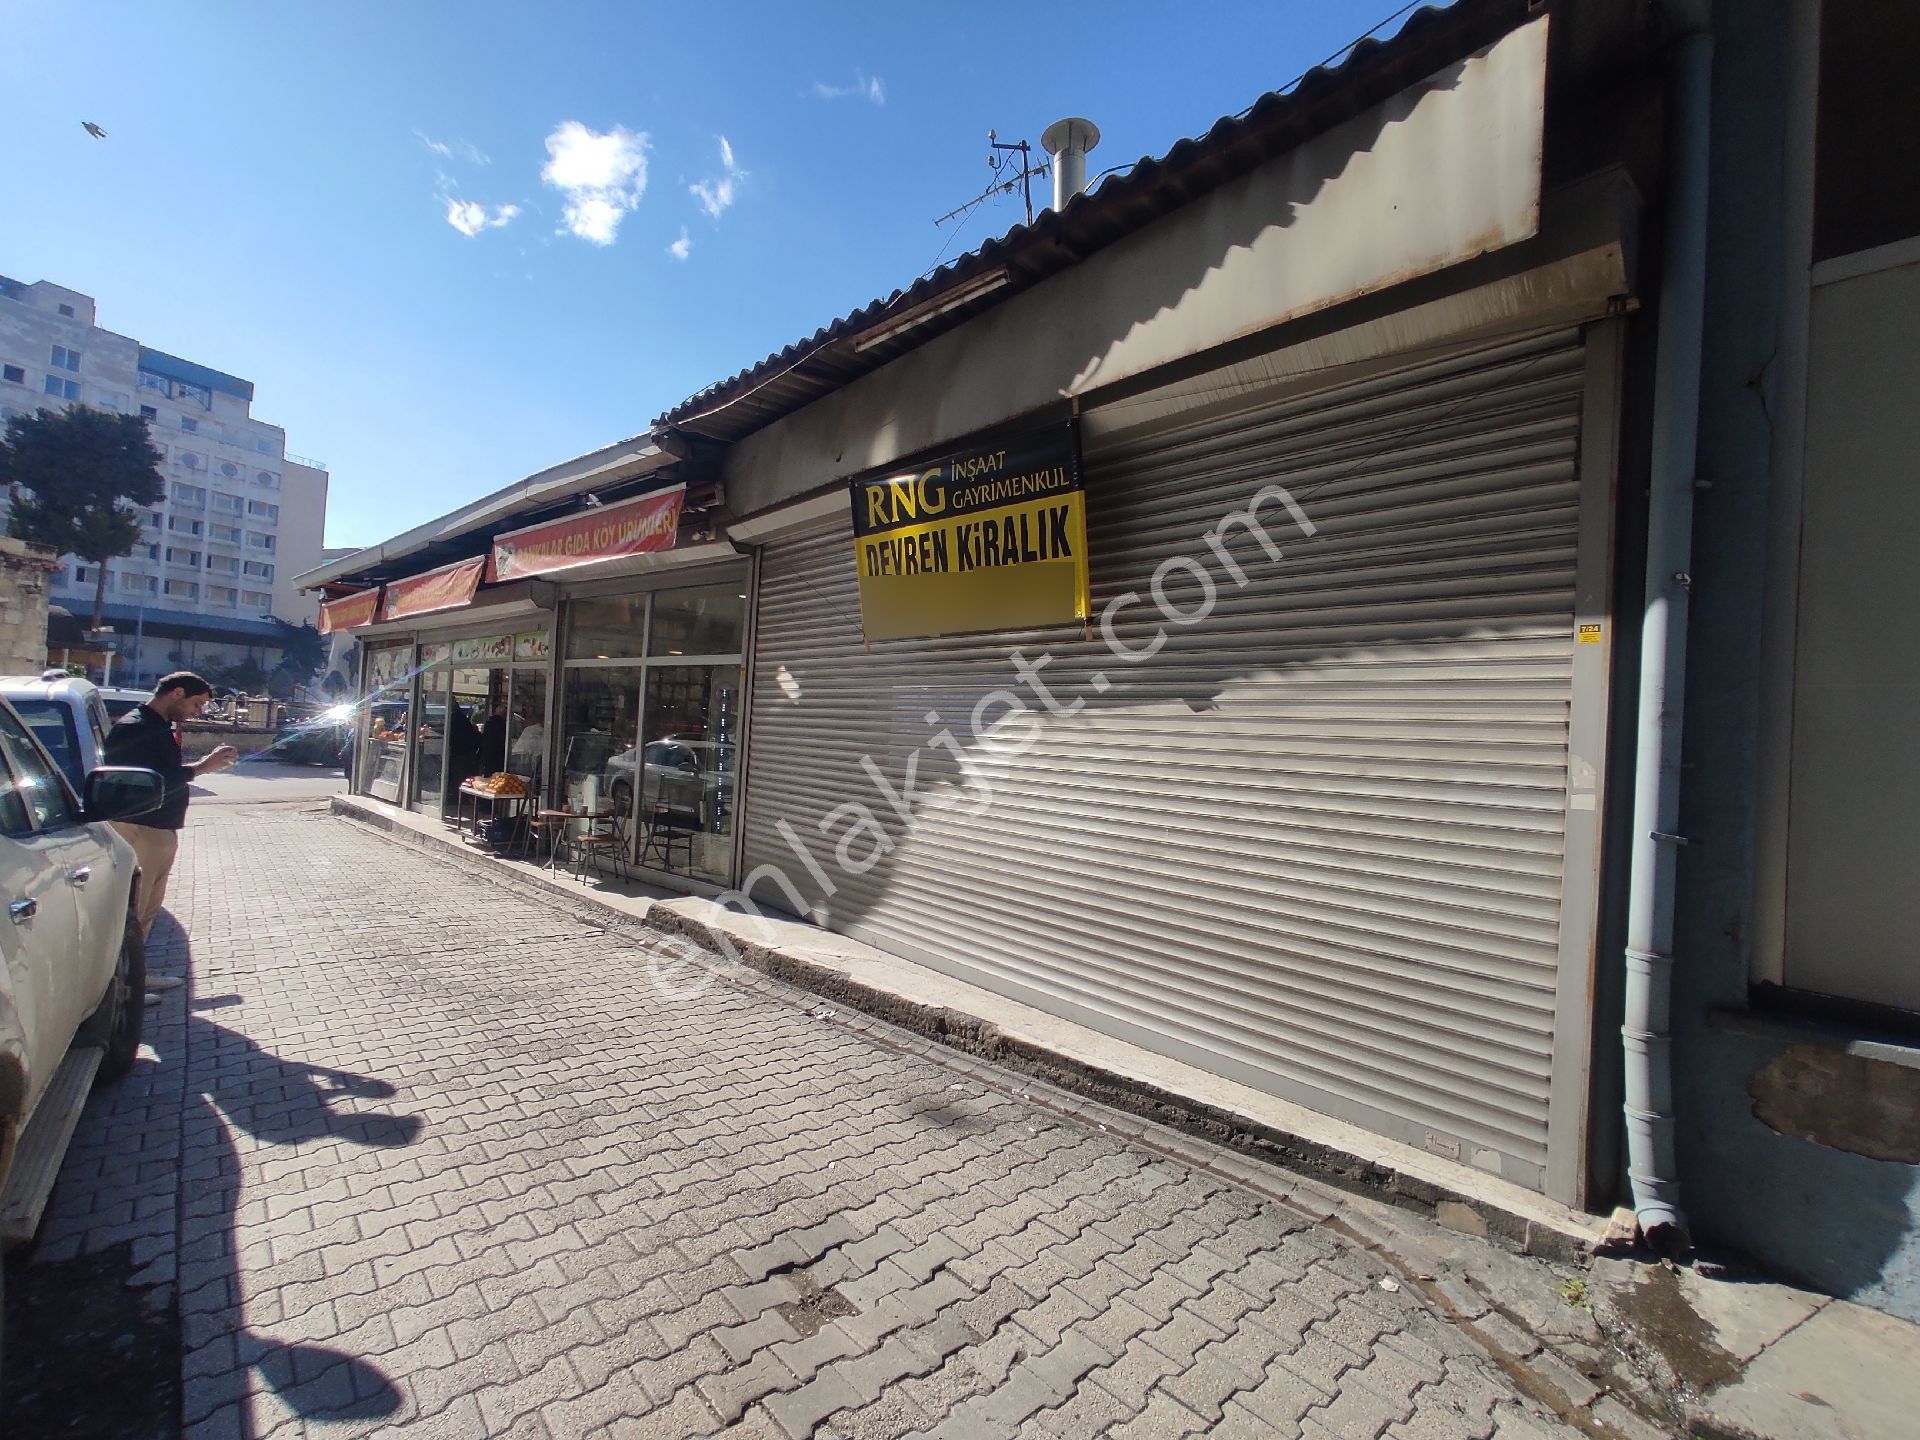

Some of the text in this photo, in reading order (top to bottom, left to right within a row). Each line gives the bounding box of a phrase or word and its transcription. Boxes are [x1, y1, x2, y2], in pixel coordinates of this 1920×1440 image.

[951, 451, 1006, 482] İNŞAAT
[866, 467, 946, 528] RNG
[952, 467, 1070, 509] GAYRİMENKUL
[565, 531, 590, 556] GIDA
[593, 521, 617, 550] KÖY
[866, 528, 949, 577] DEVREN
